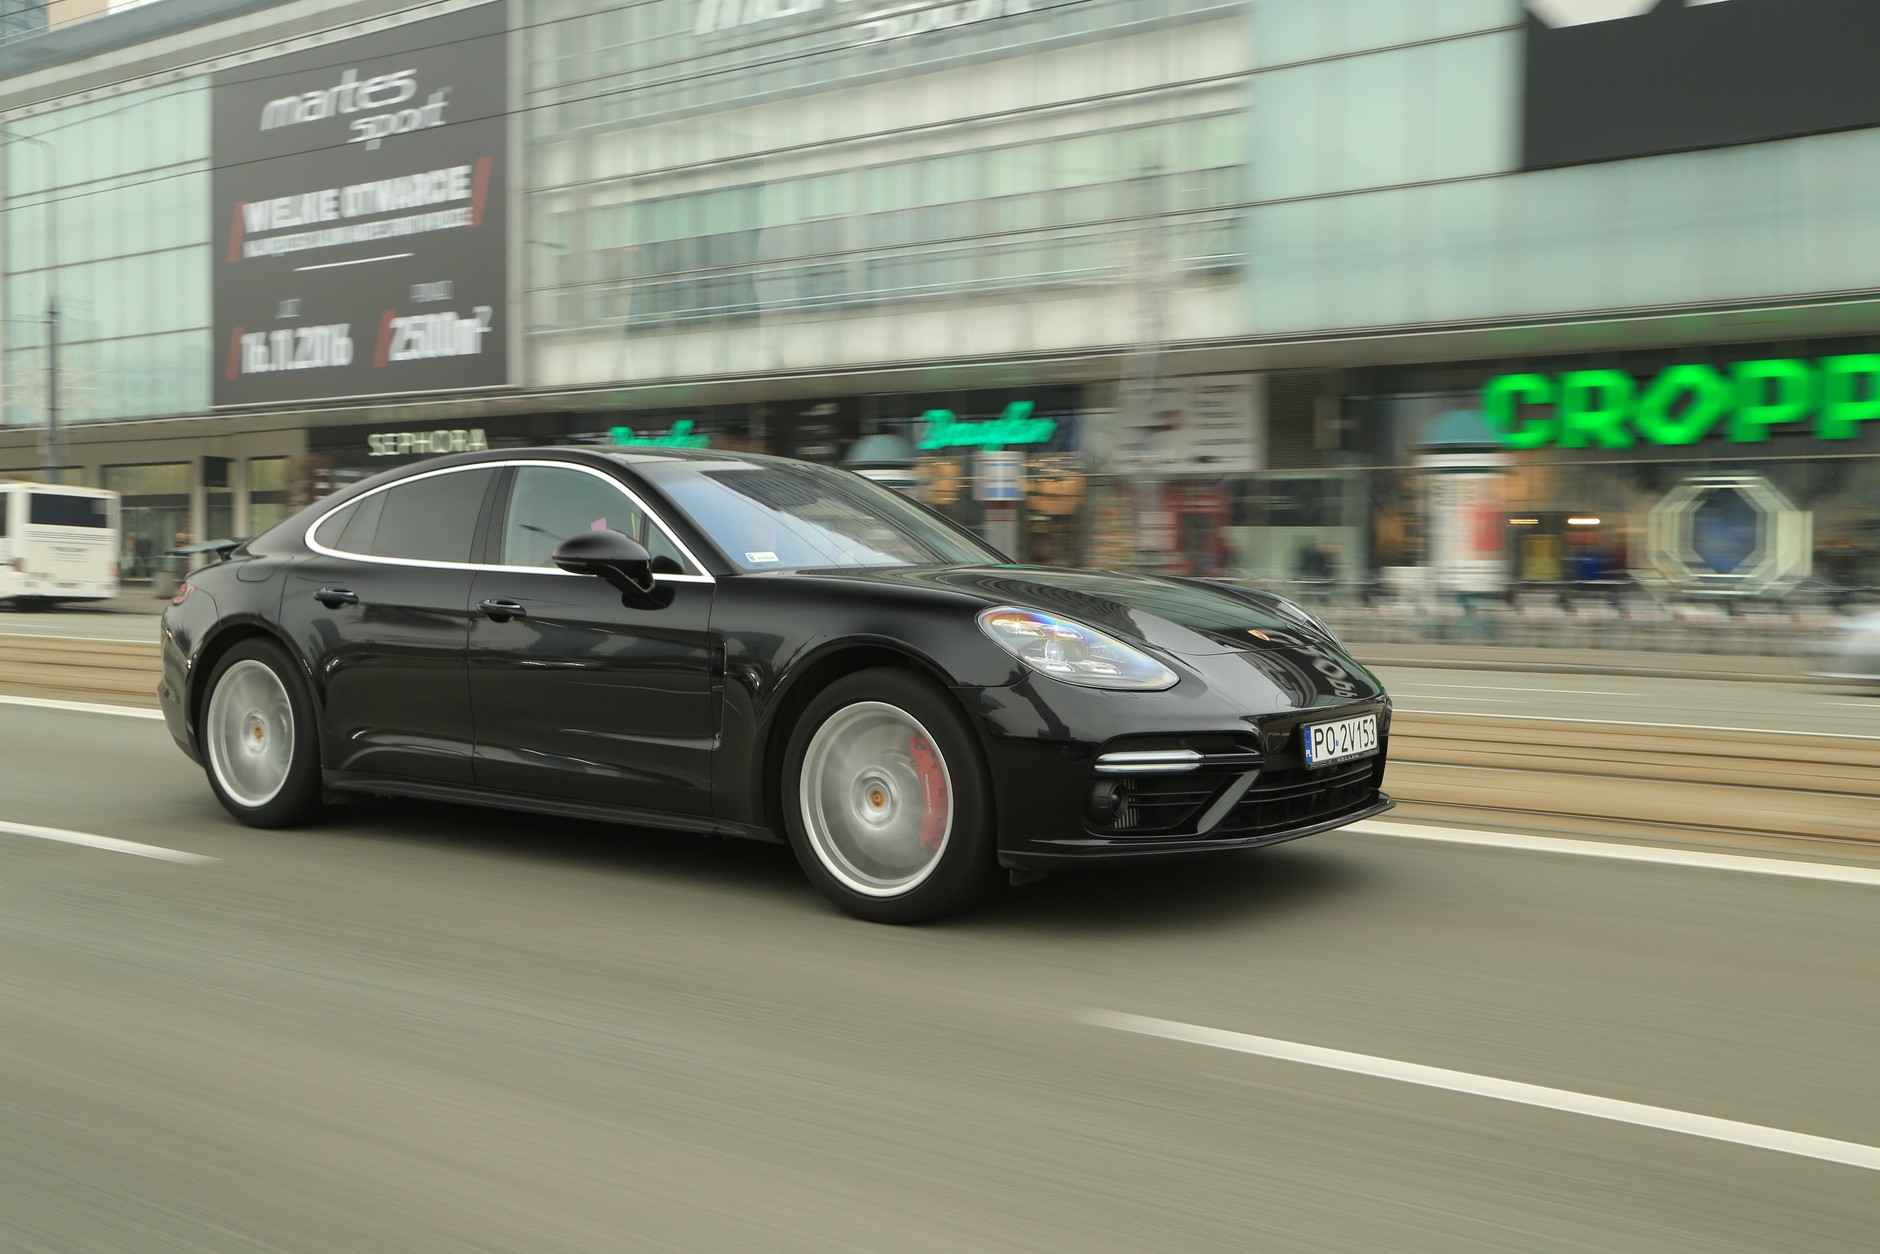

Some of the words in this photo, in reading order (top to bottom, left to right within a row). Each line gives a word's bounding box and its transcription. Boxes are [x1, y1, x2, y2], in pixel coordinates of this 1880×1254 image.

[260, 68, 417, 131] martes
[347, 87, 450, 151] sport
[1481, 353, 1880, 449] CROPP
[367, 428, 488, 456] SEPHORA
[1305, 749, 1312, 758] PL
[1314, 726, 1335, 758] PO
[1340, 718, 1375, 753] 2V153
[924, 773, 932, 815] PORSCHE
